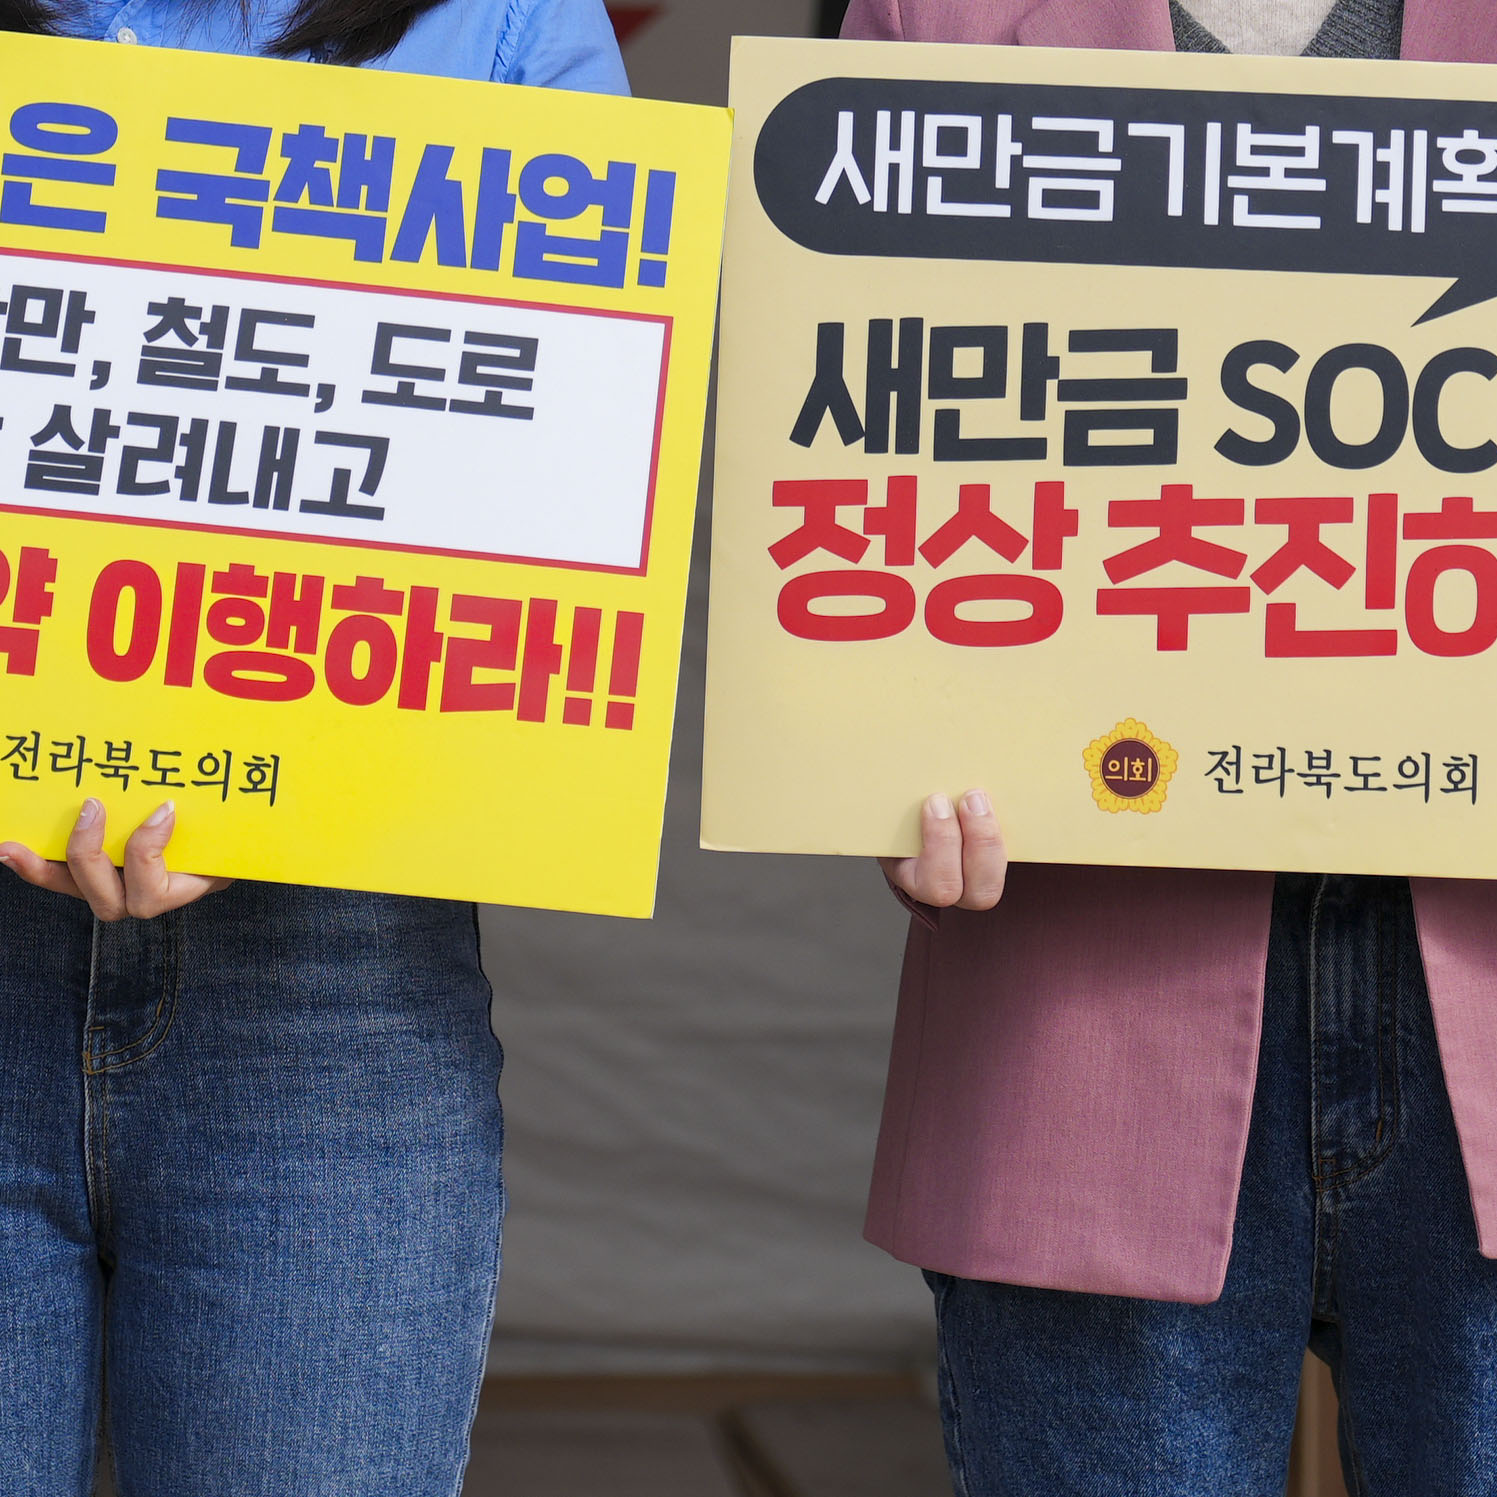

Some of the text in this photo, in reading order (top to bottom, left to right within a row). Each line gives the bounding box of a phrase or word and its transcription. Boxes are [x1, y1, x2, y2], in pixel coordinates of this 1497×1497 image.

[156, 118, 676, 288] 국책사업!
[137, 297, 335, 412] 철도,
[362, 323, 538, 419] 도로
[790, 318, 1187, 466] 새만금
[25, 405, 389, 520] 살려내고
[768, 476, 1078, 647] 정상
[88, 560, 644, 730] 이행하라!!
[1, 731, 279, 806] 전라북도의회
[1106, 757, 1151, 781] 의회
[1205, 745, 1477, 804] 전라북도의회
